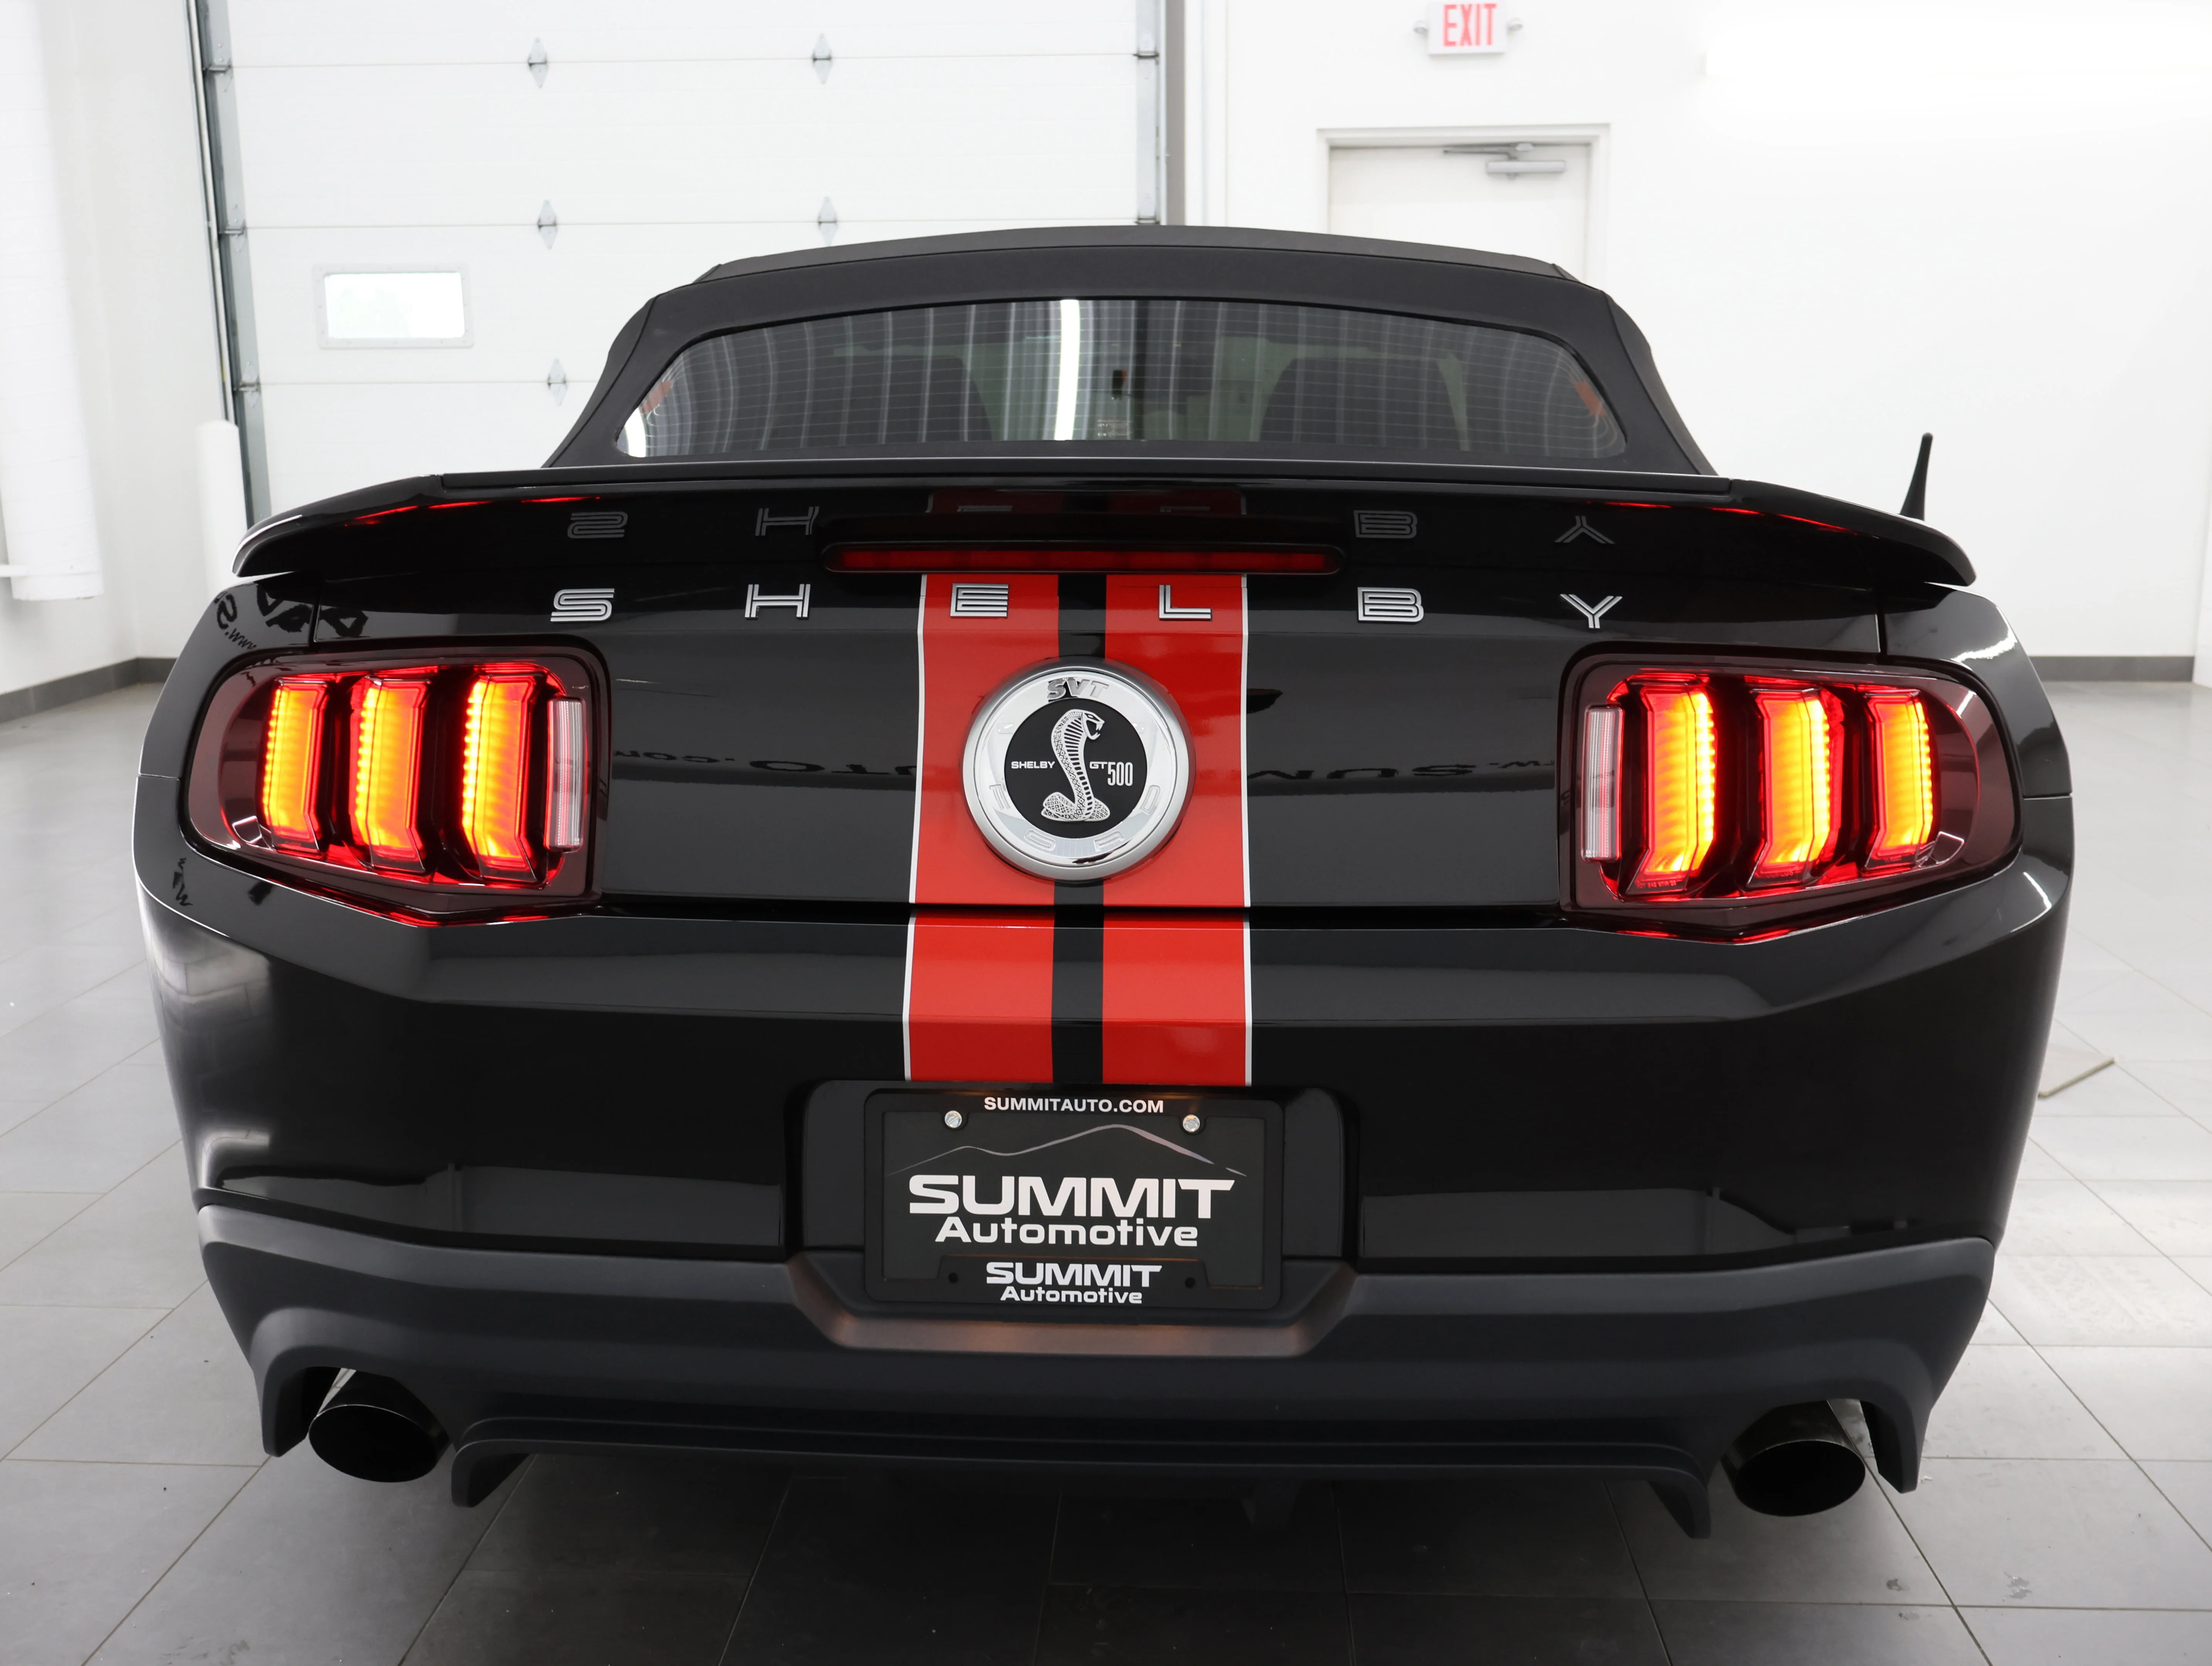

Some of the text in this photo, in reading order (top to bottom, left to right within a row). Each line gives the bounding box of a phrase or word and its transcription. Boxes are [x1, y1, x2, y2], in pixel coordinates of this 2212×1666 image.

[1443, 3, 1497, 47] EXIT
[550, 582, 1623, 629] SHELBY
[1047, 677, 1110, 700] SVT
[1011, 761, 1055, 769] SHELBY
[984, 1096, 1164, 1113] SUMMITAUTO.COM
[909, 1174, 1235, 1219] SUMMIT
[935, 1216, 1198, 1247] Automotive
[986, 1262, 1163, 1287] SUMMIT
[1000, 1285, 1142, 1304] Automotive
